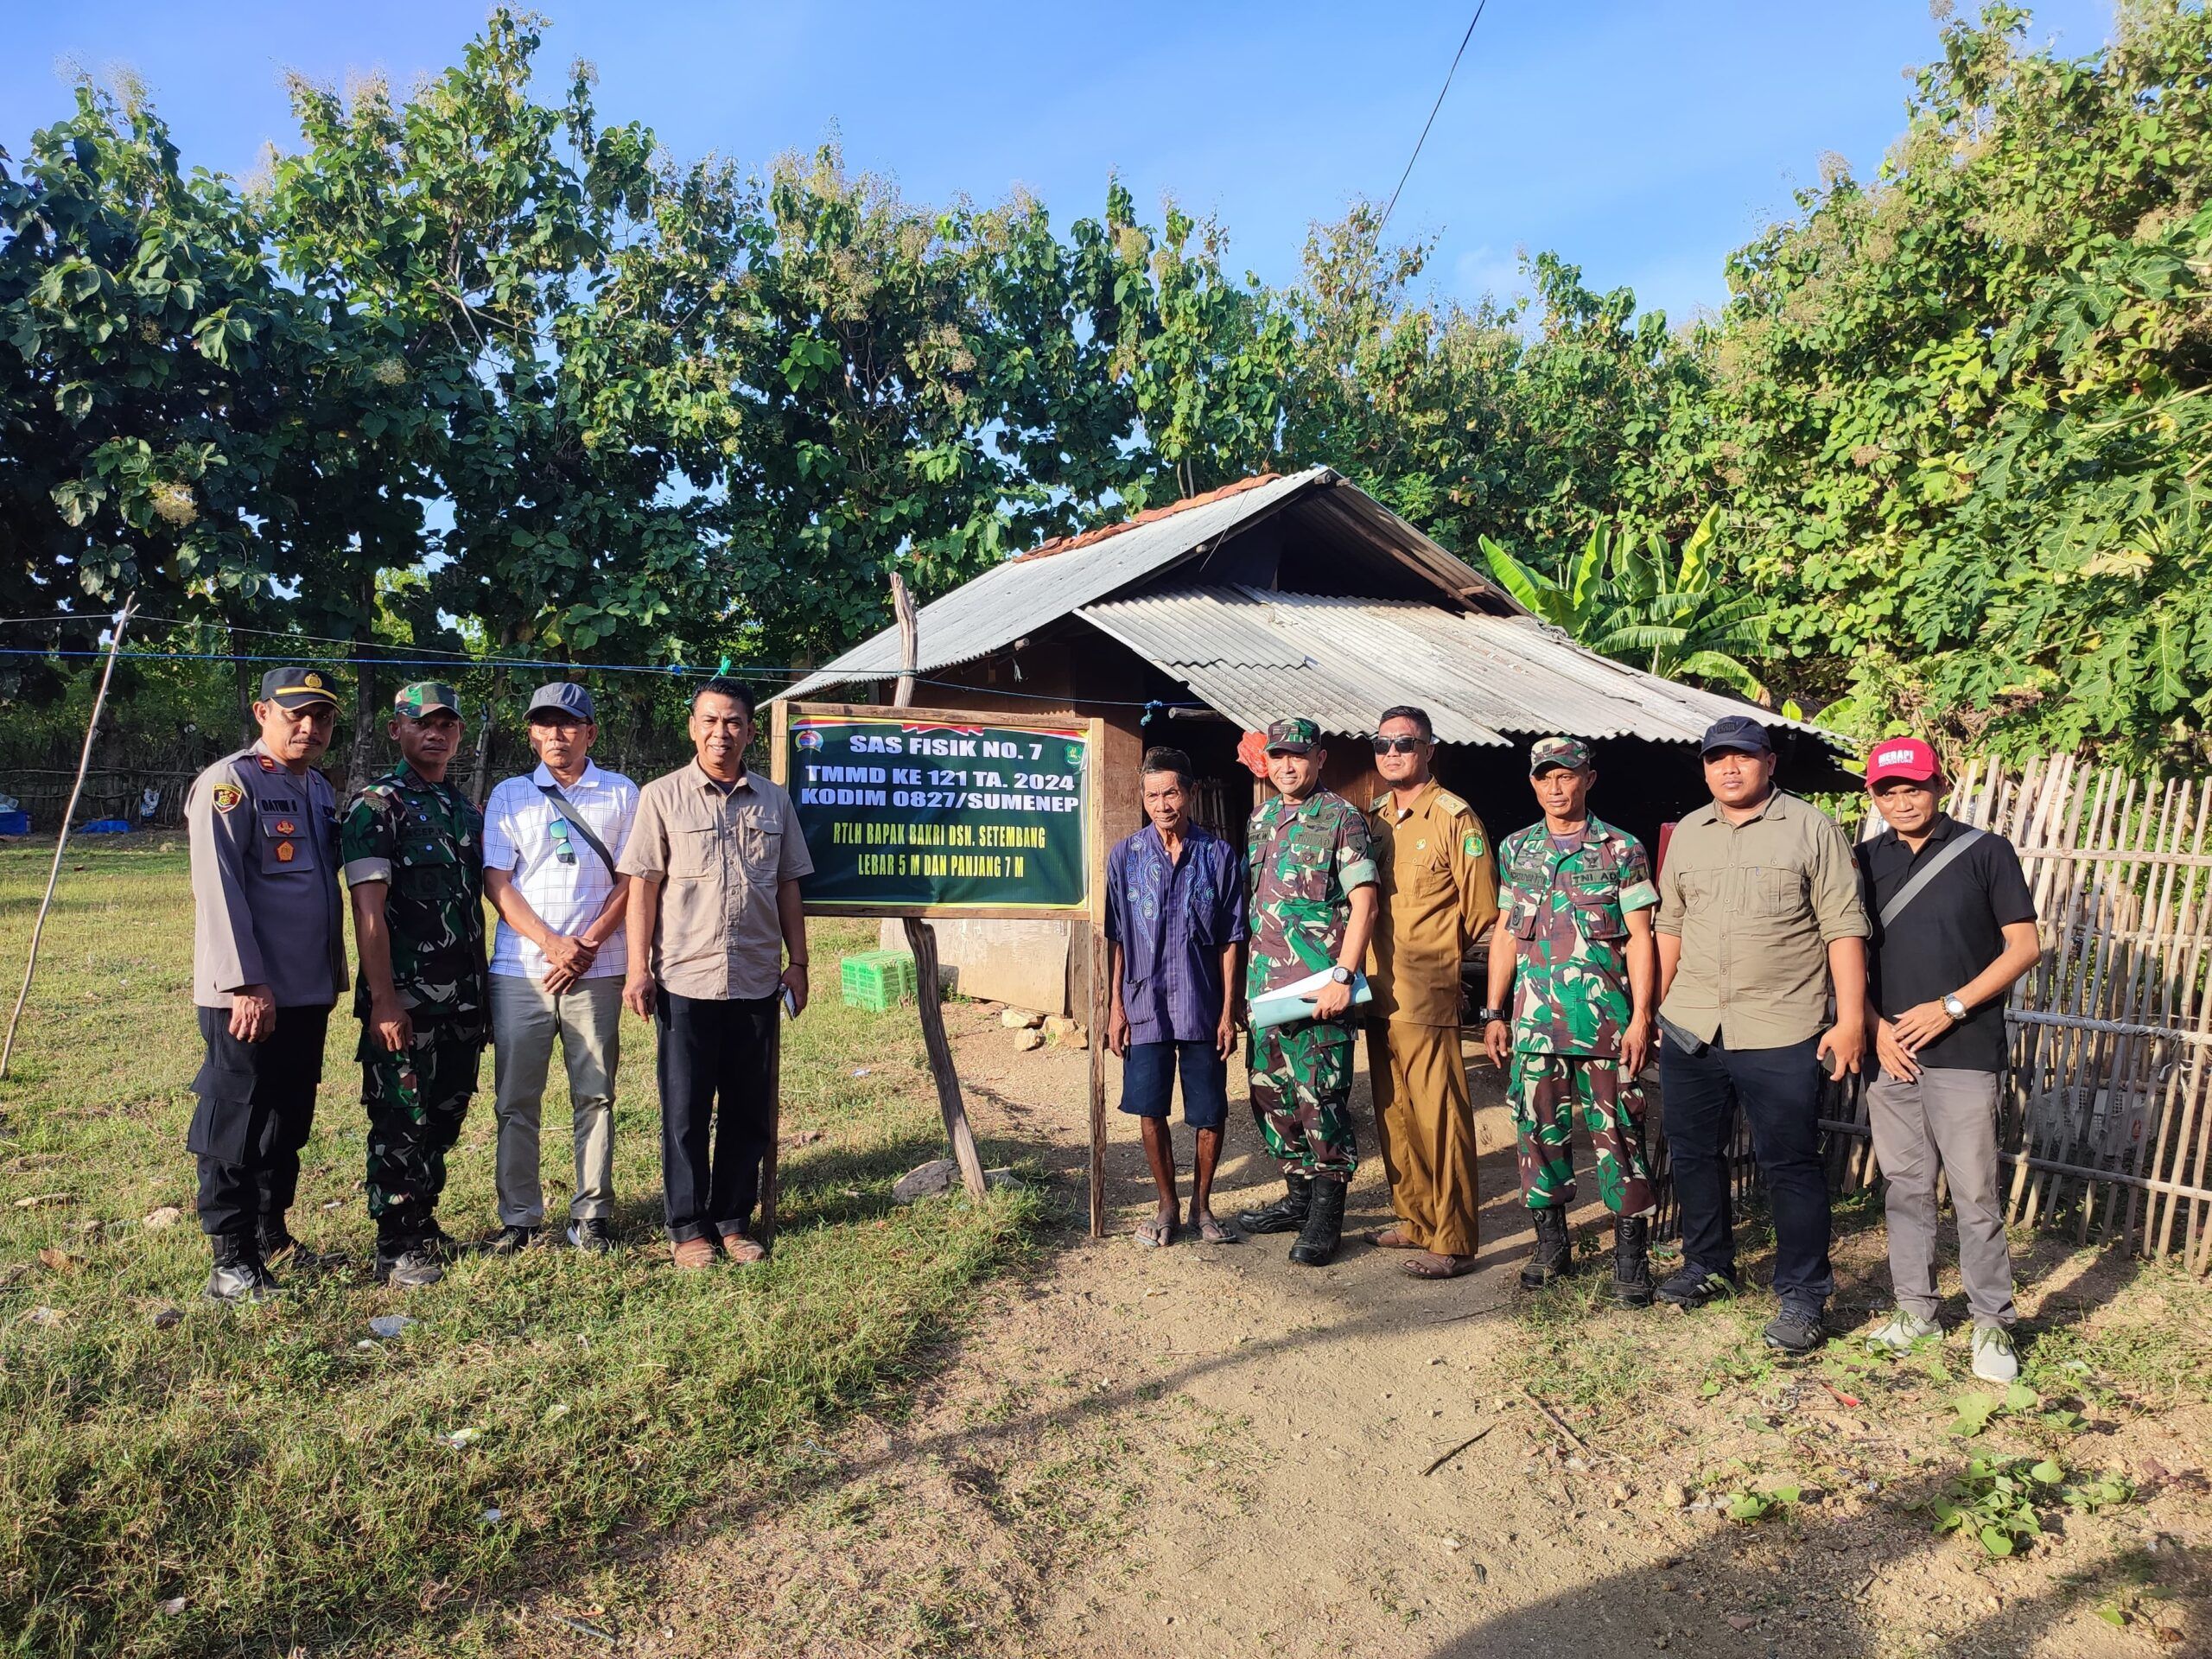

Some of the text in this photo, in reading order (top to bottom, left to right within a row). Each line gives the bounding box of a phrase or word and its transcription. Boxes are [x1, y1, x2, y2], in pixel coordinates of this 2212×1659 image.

[849, 734, 1043, 760] SAS FISIK NO. 7
[1878, 749, 1914, 762] MERAPI
[805, 765, 1075, 791] TMMD KE 121 TA. 2024
[801, 788, 1079, 812] KODIM 0827/SUMENEP
[833, 822, 1046, 849] RTLH BAPAK BAKRI DSN. SETEMBANG
[1297, 834, 1331, 848] TNI AD
[858, 854, 1024, 878] LEBAR 5 M DAN PANJANG 7 M
[1573, 871, 1617, 884] TNI AD
